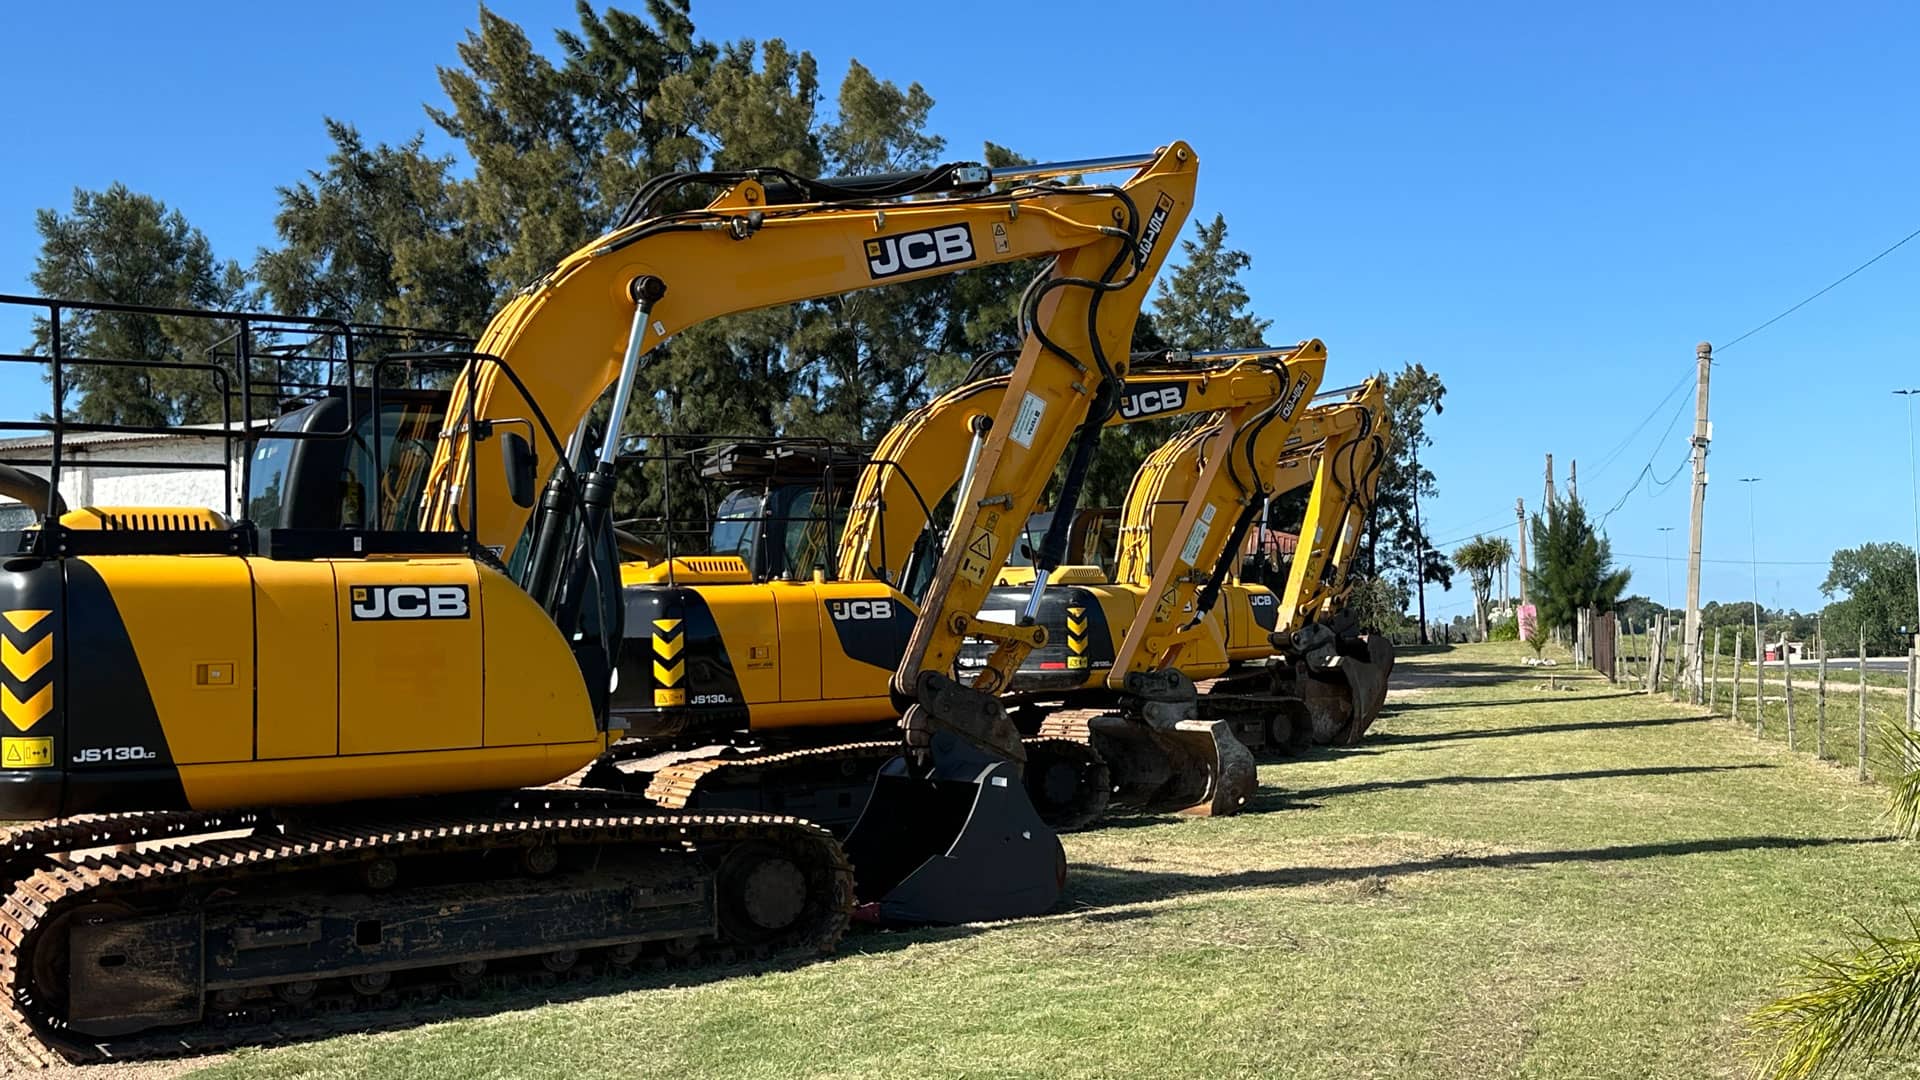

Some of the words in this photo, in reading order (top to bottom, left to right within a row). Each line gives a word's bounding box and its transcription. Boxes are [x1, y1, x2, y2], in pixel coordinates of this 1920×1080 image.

[870, 226, 973, 275] JCB
[1122, 386, 1183, 417] JCB
[353, 587, 468, 619] JCB
[833, 600, 892, 620] JCB
[1250, 595, 1272, 606] JCB
